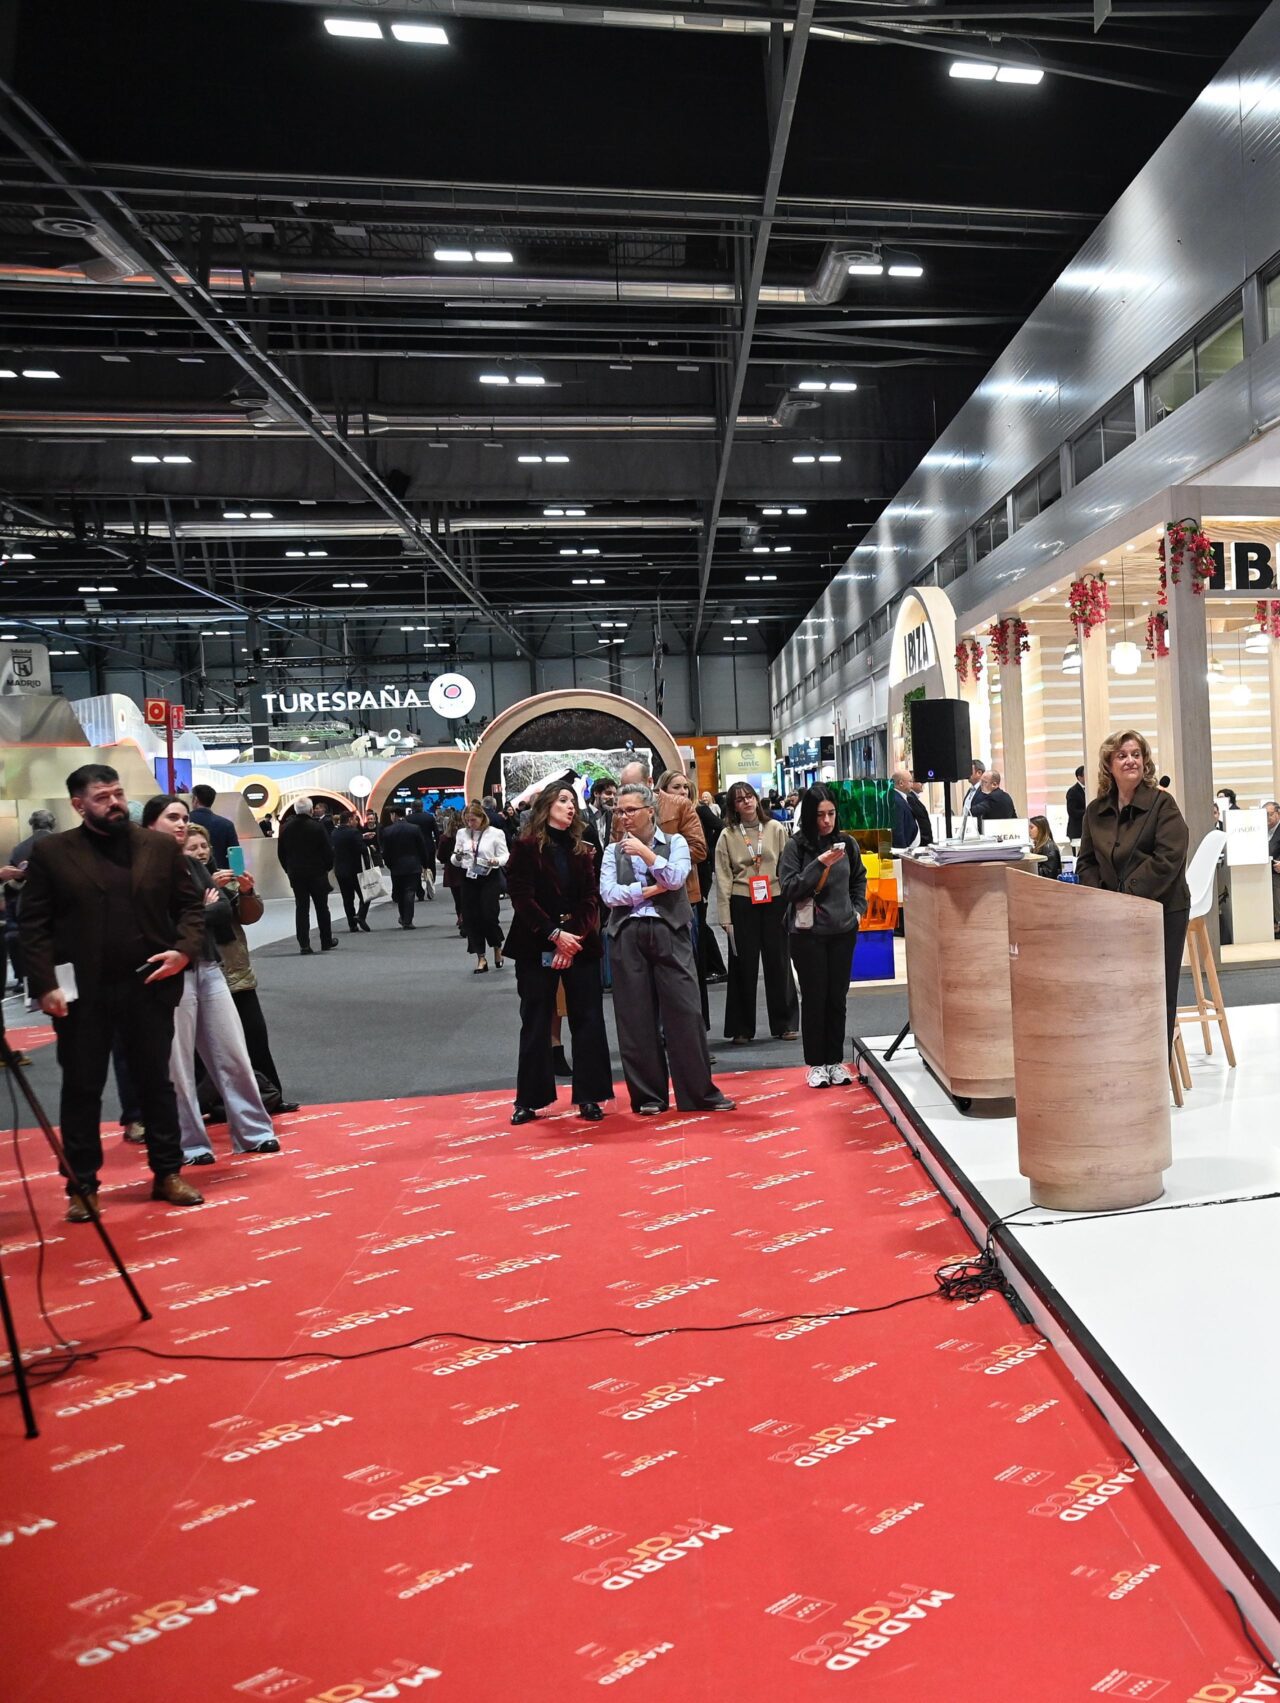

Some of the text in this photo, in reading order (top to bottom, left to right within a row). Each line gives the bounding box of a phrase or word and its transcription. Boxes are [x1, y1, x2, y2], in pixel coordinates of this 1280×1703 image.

[6, 679, 42, 689] MADRID
[261, 684, 422, 714] TURESPAÑA
[762, 1228, 833, 1252] MADRID
[476, 1254, 561, 1279] MADRID
[635, 1279, 719, 1308] MADRID
[311, 1307, 413, 1337] MADRID
[433, 1343, 536, 1375] MADRID
[984, 1340, 1049, 1375] ADRID
[56, 1374, 186, 1416] MADRID
[622, 1377, 724, 1420] MADRID
[1016, 1400, 1059, 1423] MADRID
[223, 1415, 353, 1462] MADRID
[794, 1417, 896, 1466] MADRID
[621, 1451, 677, 1476] MADRID
[368, 1466, 500, 1520] MADRID
[870, 1503, 924, 1534] MADRID
[603, 1525, 733, 1589] MADRID
[1109, 1564, 1160, 1599] MADRID
[77, 1585, 259, 1665] MADRID
[826, 1590, 954, 1670] MADRID
[599, 1642, 674, 1684] MADRID
